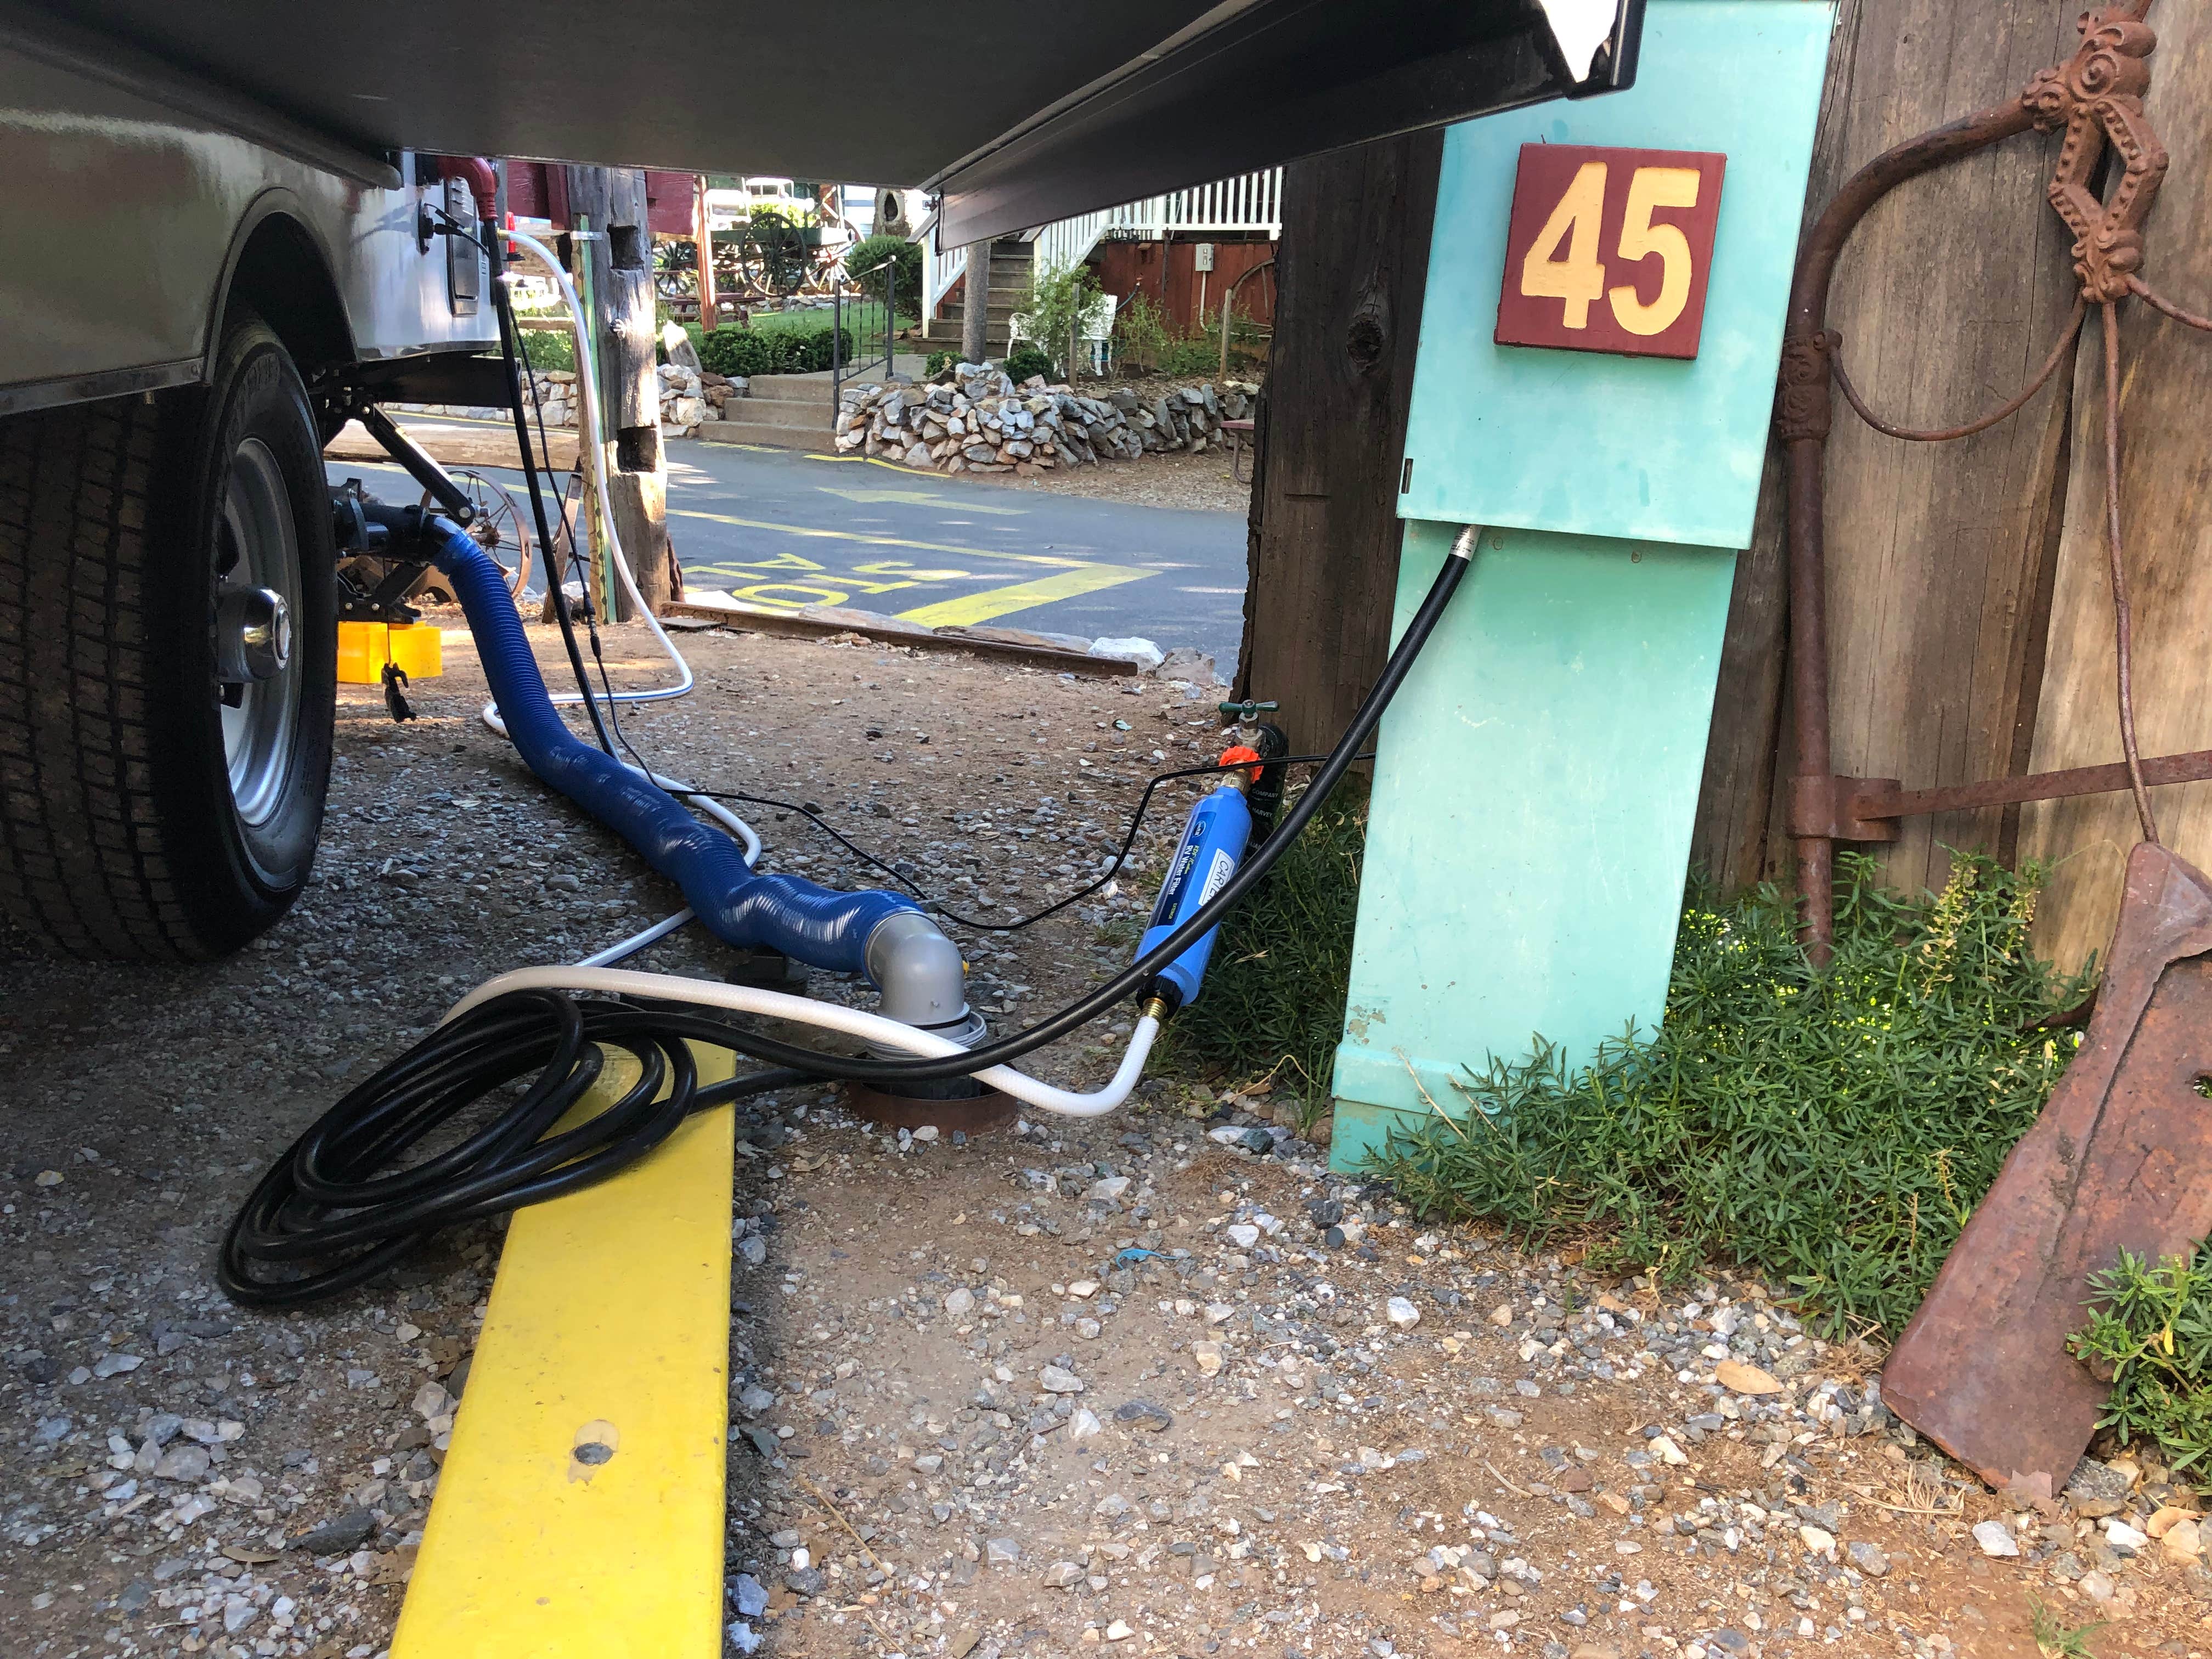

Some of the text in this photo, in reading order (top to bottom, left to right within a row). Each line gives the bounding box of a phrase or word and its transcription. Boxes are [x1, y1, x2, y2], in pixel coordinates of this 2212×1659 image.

[1521, 161, 1701, 336] 45
[1251, 788, 1279, 799] COMPANY
[1252, 807, 1273, 818] HARVEY
[1184, 845, 1194, 855] RV
[1176, 856, 1190, 877] Water
[1169, 877, 1182, 895] Filter
[1209, 860, 1229, 898] CARTE
